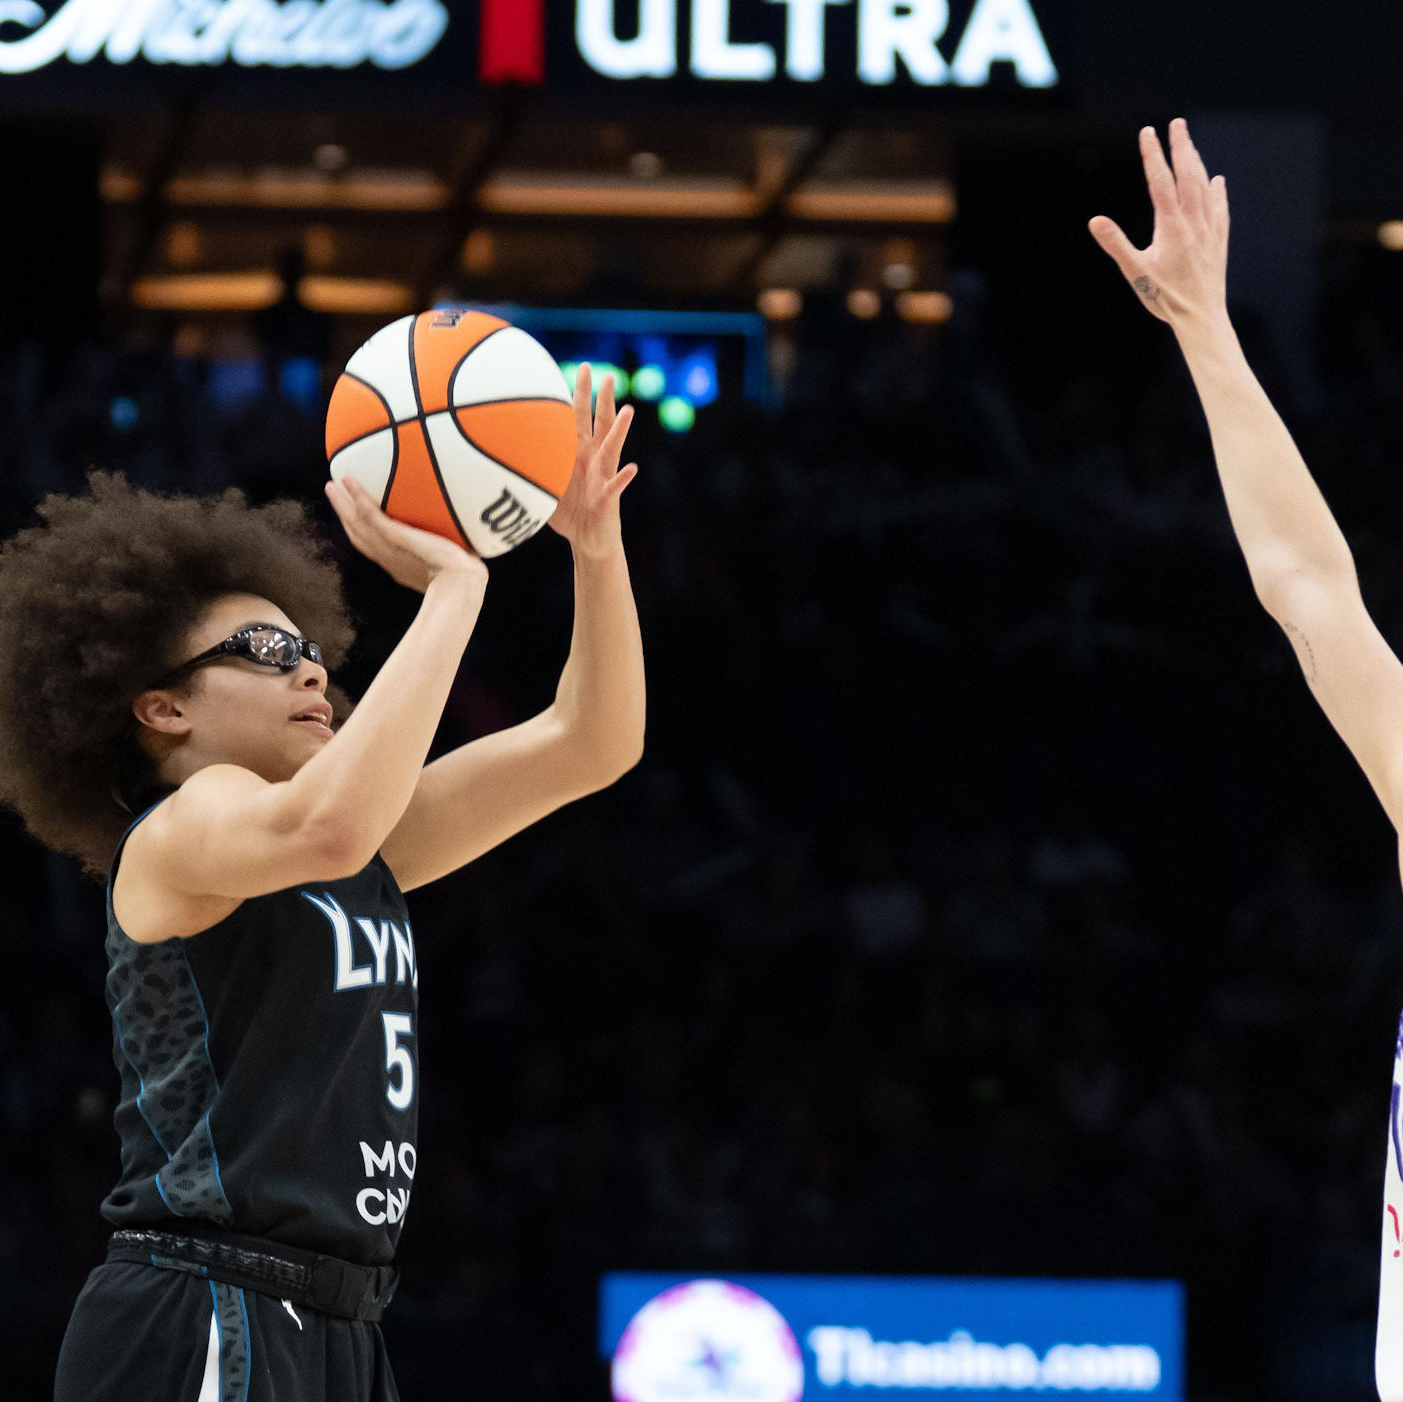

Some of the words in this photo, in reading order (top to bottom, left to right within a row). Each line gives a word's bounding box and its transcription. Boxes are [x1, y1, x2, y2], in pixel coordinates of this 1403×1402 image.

[575, 0, 1060, 87] ULTRA
[480, 486, 542, 546] Wil
[301, 891, 418, 993] LYN
[380, 1010, 414, 1111] 5
